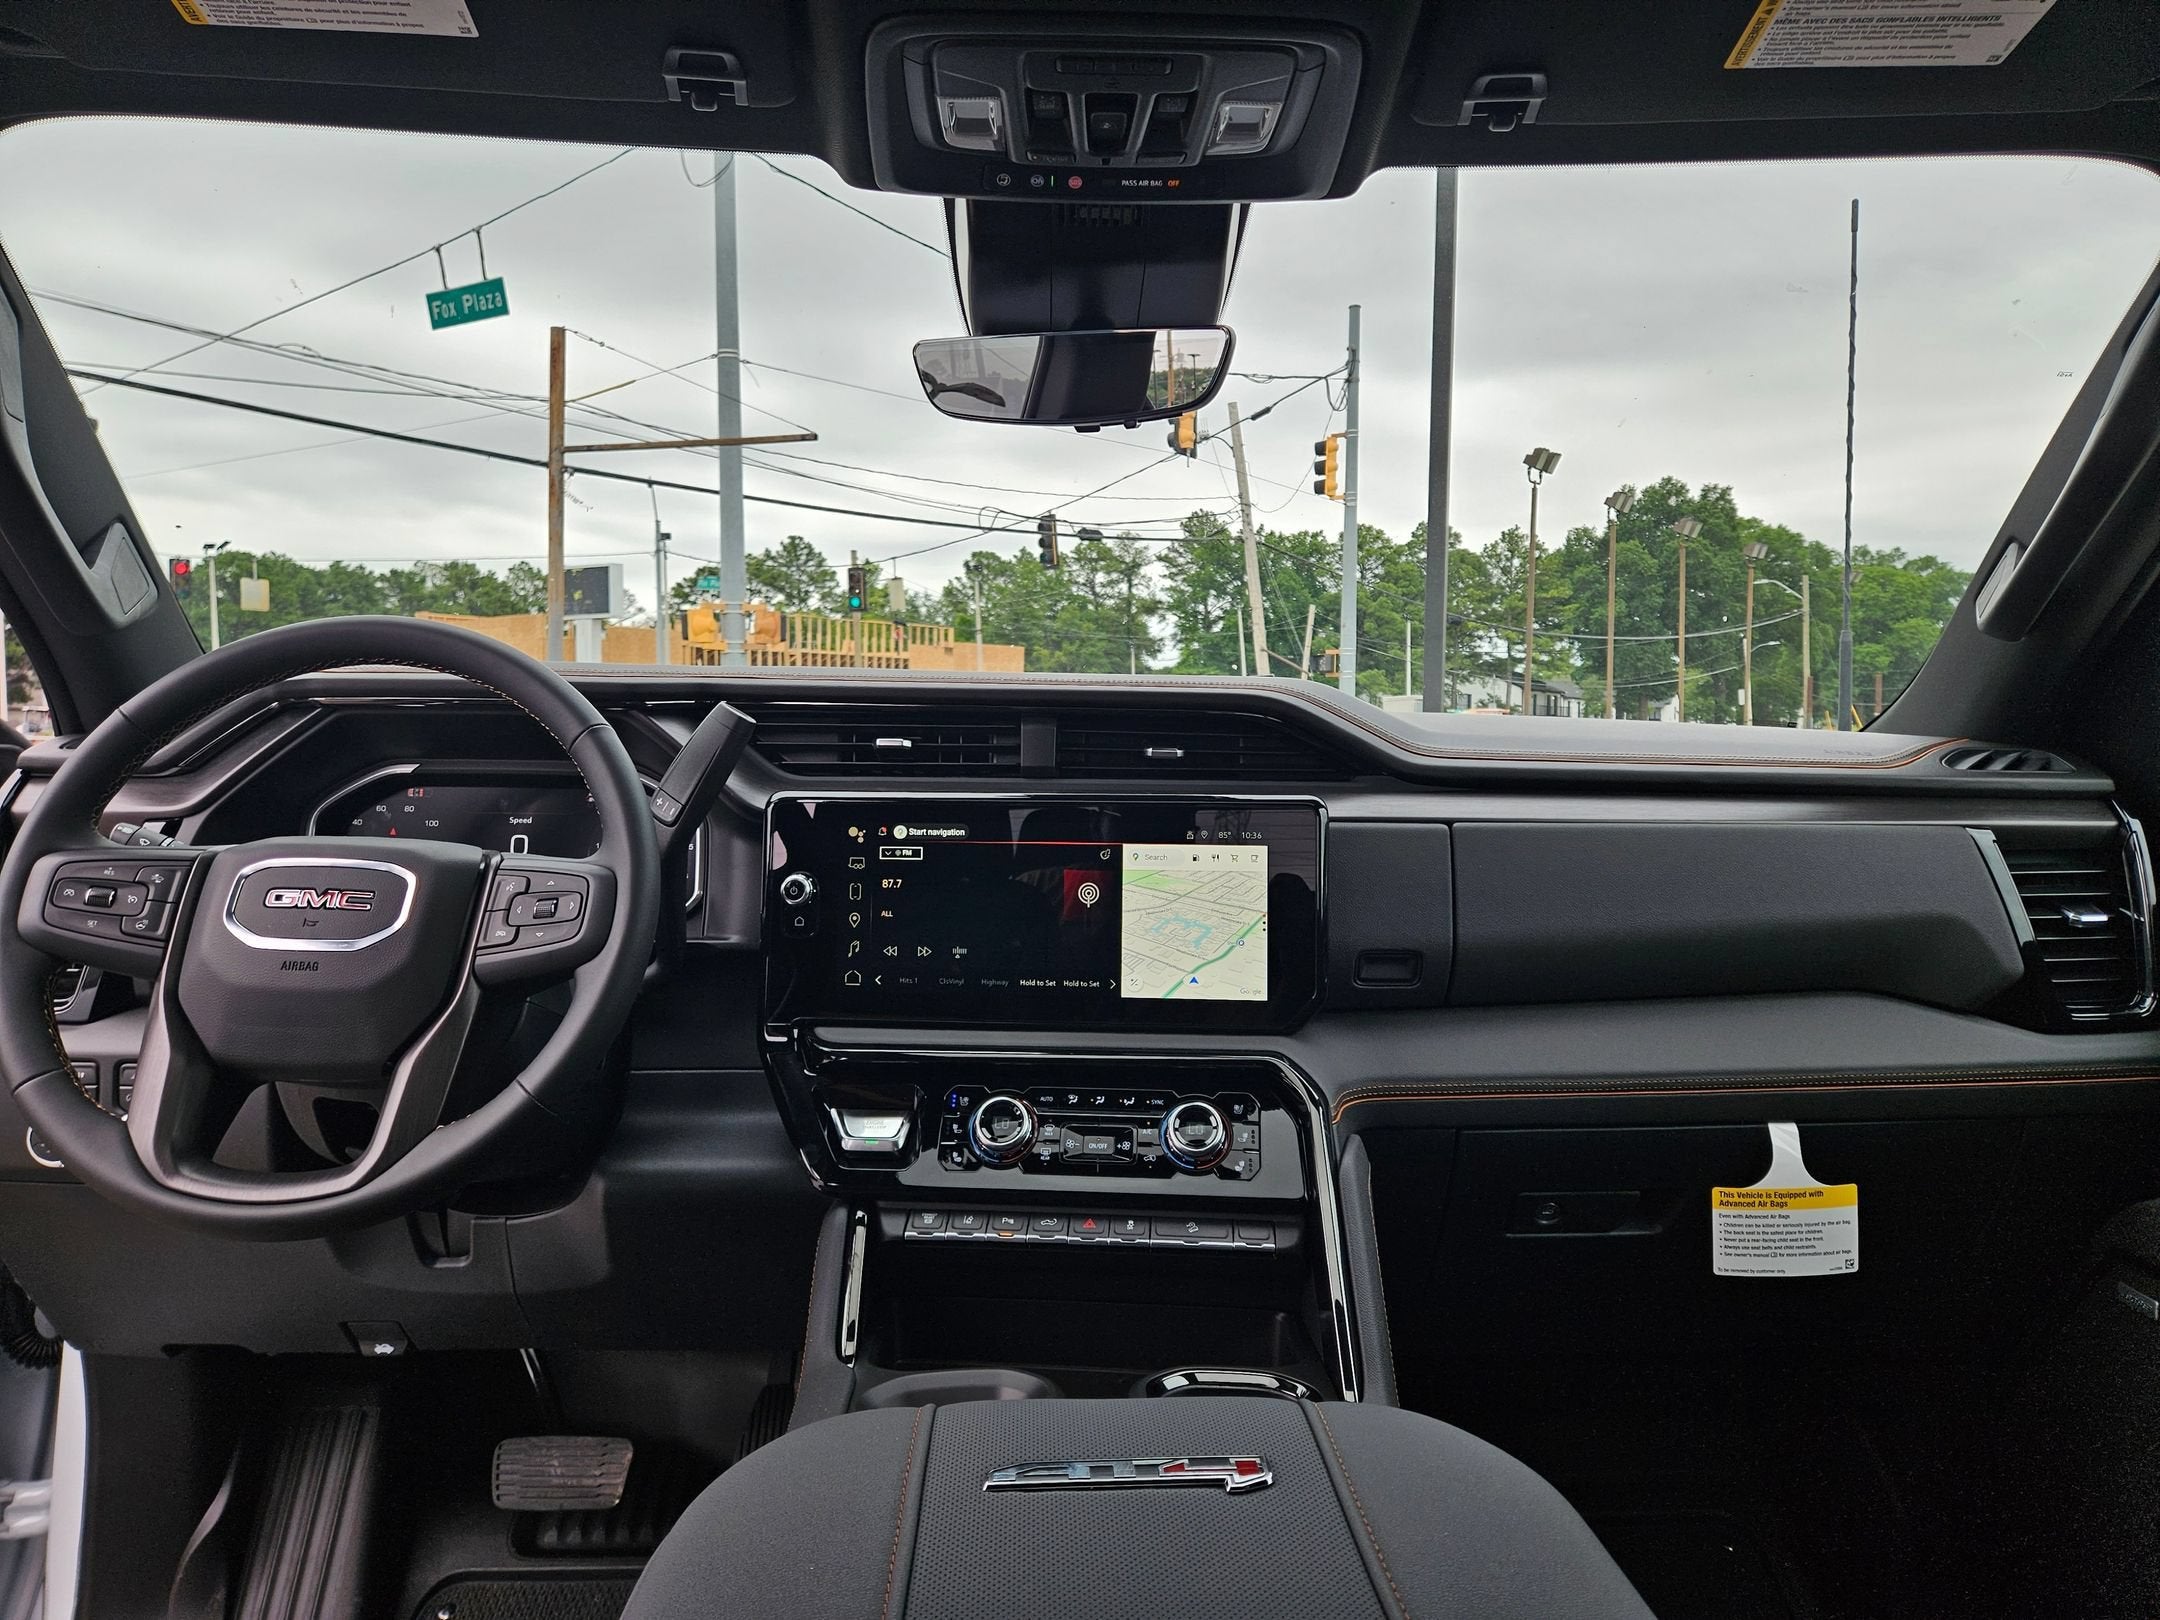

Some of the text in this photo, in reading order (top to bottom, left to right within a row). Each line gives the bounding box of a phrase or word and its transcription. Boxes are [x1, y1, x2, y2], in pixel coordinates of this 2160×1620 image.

[1802, 17, 1828, 25] AVEC
[1121, 179, 1137, 187] PASS
[1138, 179, 1149, 187] AIR
[431, 291, 503, 321] Fox Plaza
[376, 804, 415, 813] 60 80
[352, 818, 439, 827] 40 100
[509, 816, 533, 825] Speed
[908, 828, 966, 837] Start navigation
[1241, 831, 1263, 839] 10:36
[1144, 853, 1168, 861] Search
[881, 879, 903, 889] 87.7
[264, 887, 375, 911] GMC
[280, 960, 320, 972] AIRBAG
[981, 978, 1009, 987] Highway
[1019, 978, 1057, 987] Hold to Set
[1063, 979, 1100, 988] Hold to Set
[1239, 987, 1263, 996] Gogle
[1719, 1190, 1735, 1199] This
[1737, 1191, 1764, 1200] Vehicle
[1774, 1190, 1807, 1200] Equipped
[1808, 1190, 1824, 1198] with
[1719, 1200, 1789, 1209] Advanced Air Bags
